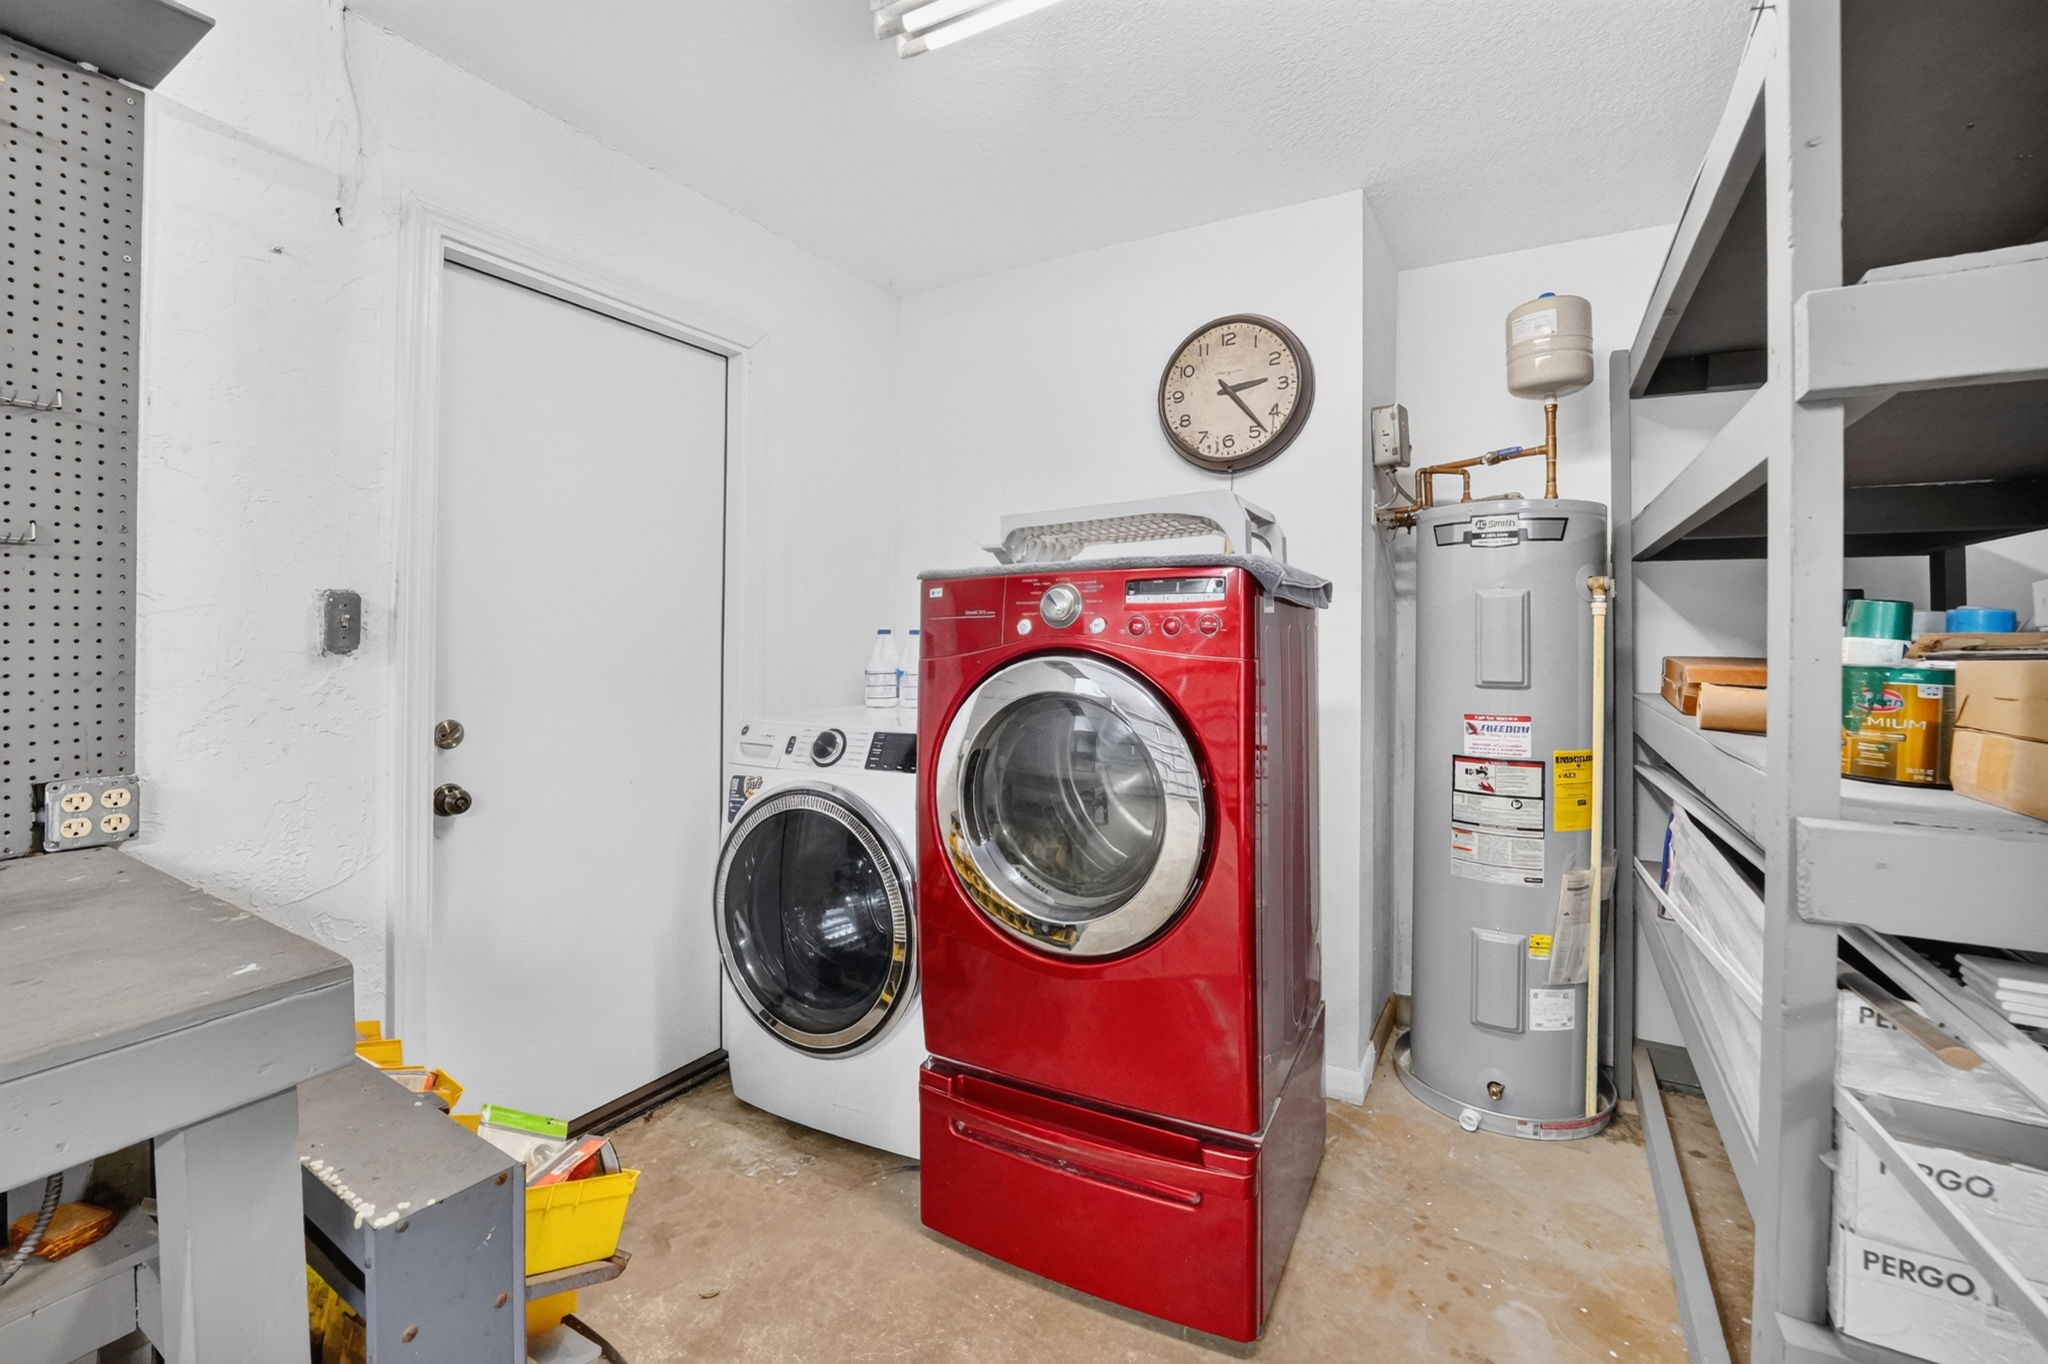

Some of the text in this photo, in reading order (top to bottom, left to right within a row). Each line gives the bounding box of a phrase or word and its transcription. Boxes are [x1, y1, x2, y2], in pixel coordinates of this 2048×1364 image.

[1221, 332, 1237, 346] 12
[1199, 343, 1209, 357] 11
[1268, 351, 1282, 366] 2
[1180, 364, 1195, 379] 10
[1277, 376, 1289, 390] 3
[1172, 390, 1185, 404] 9
[1268, 403, 1280, 417] 4
[1179, 414, 1191, 428] 8
[1198, 431, 1209, 444] 7
[1249, 425, 1261, 439] 5
[1222, 435, 1235, 448] 6
[1863, 1250, 1975, 1296] PERGO
